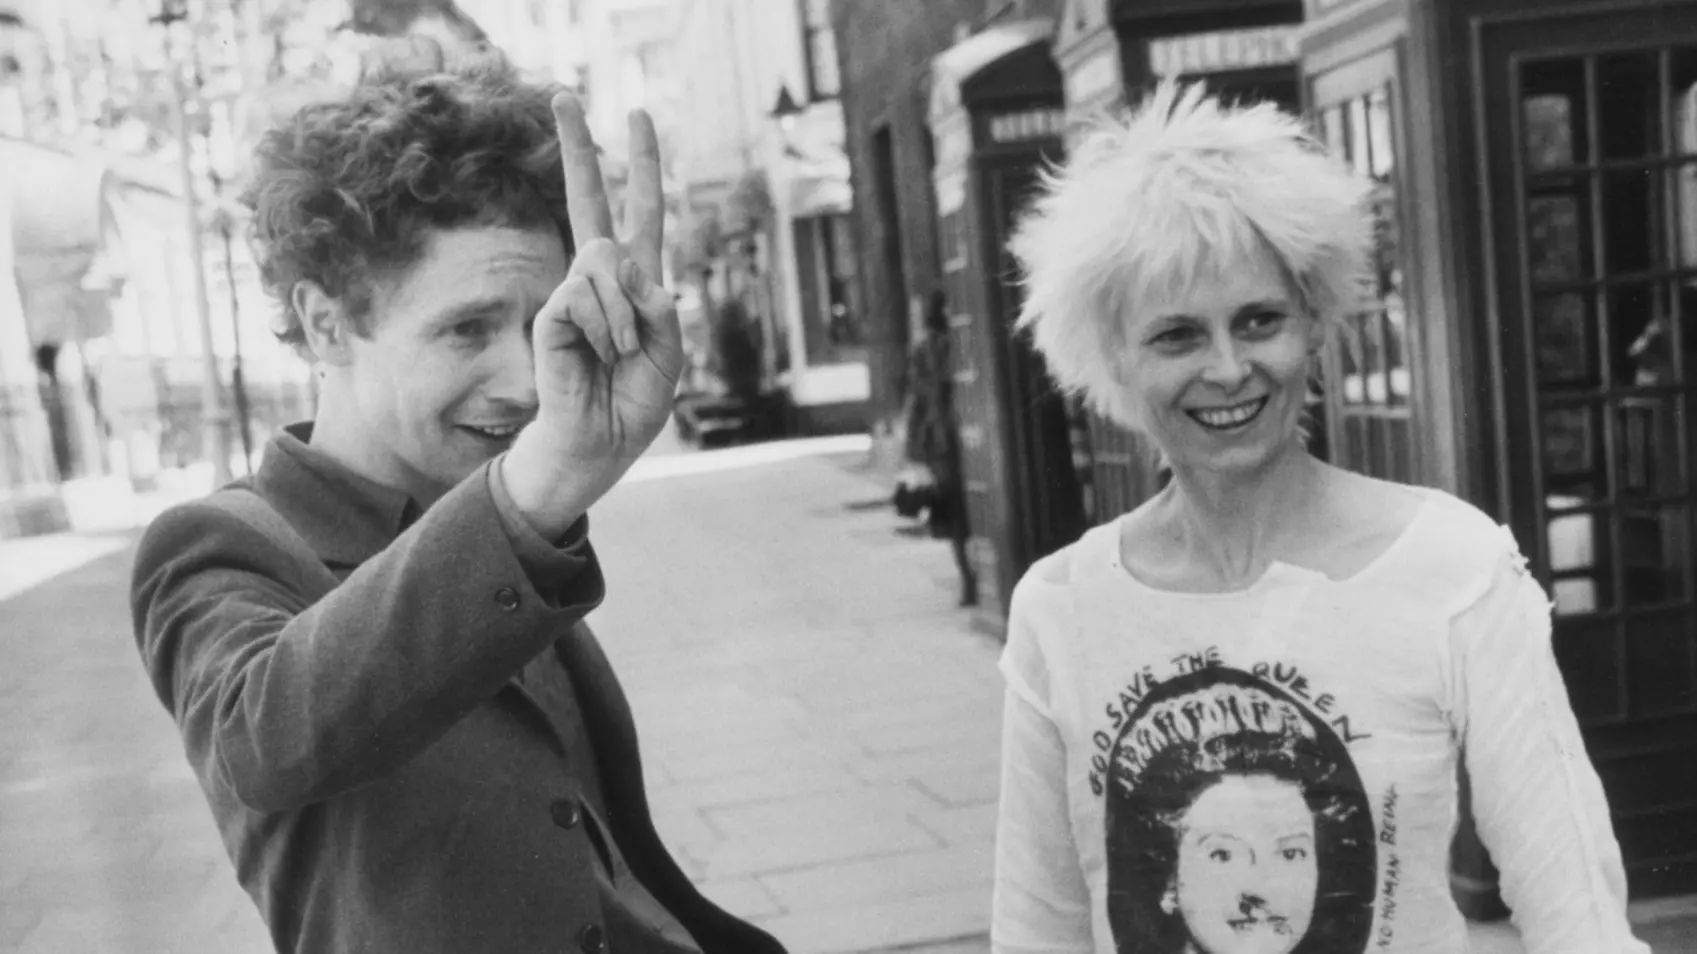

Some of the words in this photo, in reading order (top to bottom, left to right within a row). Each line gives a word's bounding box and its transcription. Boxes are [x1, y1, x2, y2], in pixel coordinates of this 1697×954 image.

[1088, 729, 1112, 797] GOD
[1106, 665, 1159, 730] SAVE
[1171, 646, 1224, 675] THE
[1252, 662, 1373, 743] QUEEN
[1379, 855, 1400, 921] HUMAN
